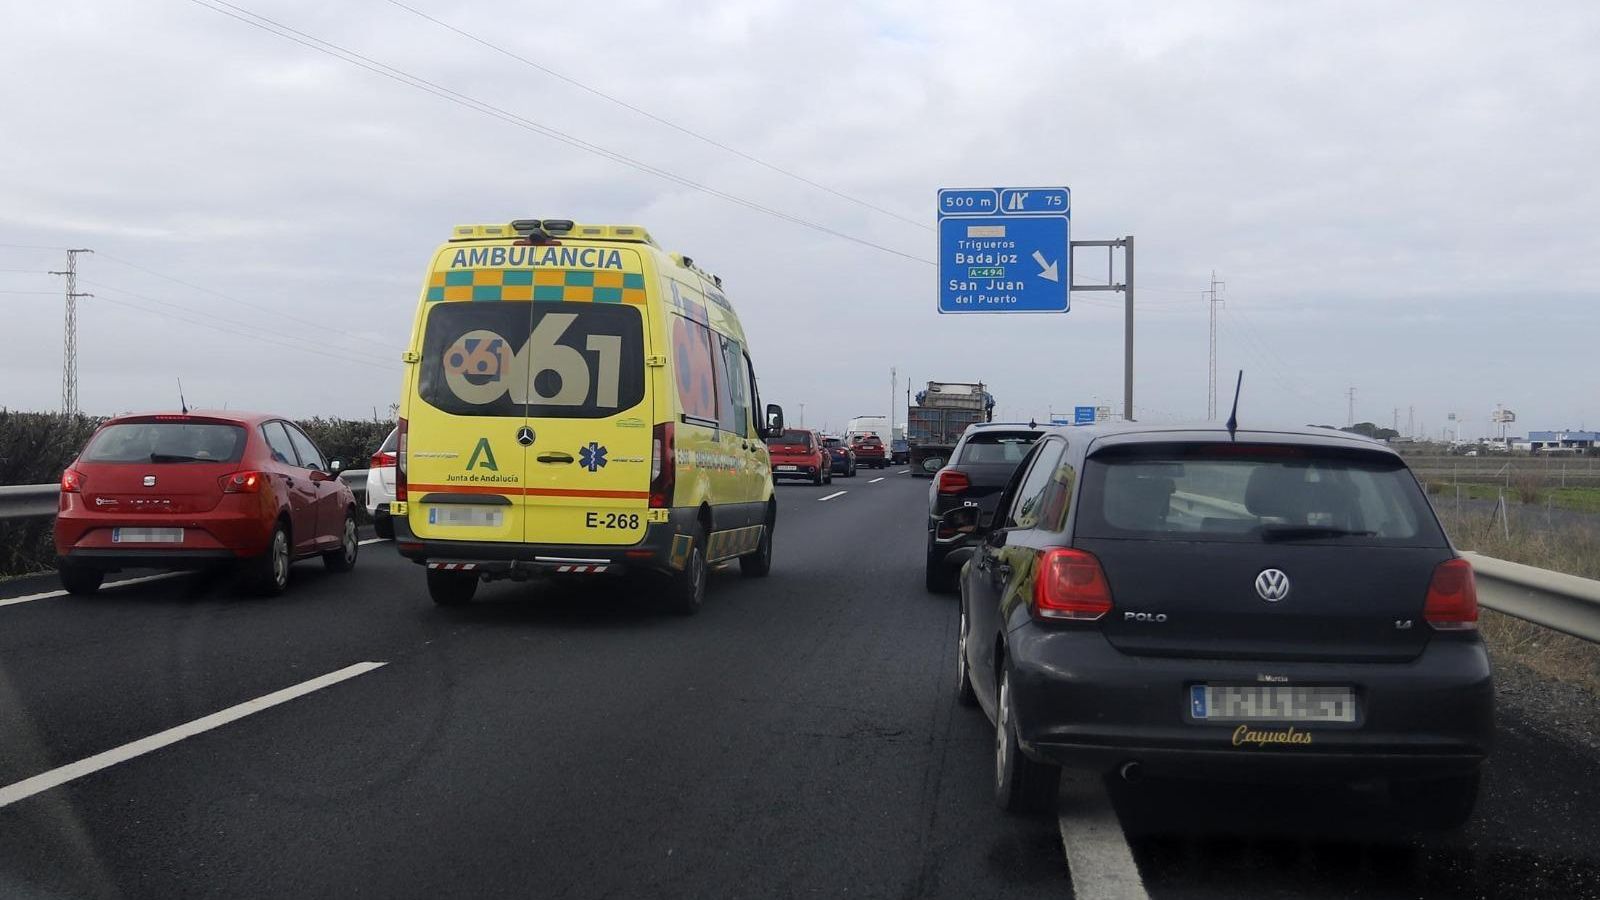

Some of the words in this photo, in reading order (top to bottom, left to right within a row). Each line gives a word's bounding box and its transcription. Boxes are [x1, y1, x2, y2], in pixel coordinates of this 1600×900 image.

[946, 197, 974, 207] 500
[980, 199, 991, 207] m
[1045, 196, 1062, 206] 75
[958, 240, 1015, 251] Trigueros
[451, 246, 623, 269] AMBULANCIA
[955, 252, 1018, 266] Badajoz
[970, 268, 1003, 277] A-494
[949, 280, 977, 291] San
[986, 280, 1024, 291] Juan
[955, 295, 973, 304] del
[978, 295, 1017, 303] Puerto
[444, 313, 622, 408] 061
[446, 474, 468, 482] Junta
[470, 474, 479, 482] de
[481, 474, 519, 483] Andalucía
[585, 512, 639, 530] E-268
[1124, 612, 1167, 623] POLO
[1265, 674, 1288, 682] Murcia
[1232, 725, 1313, 747] Cayuelas
